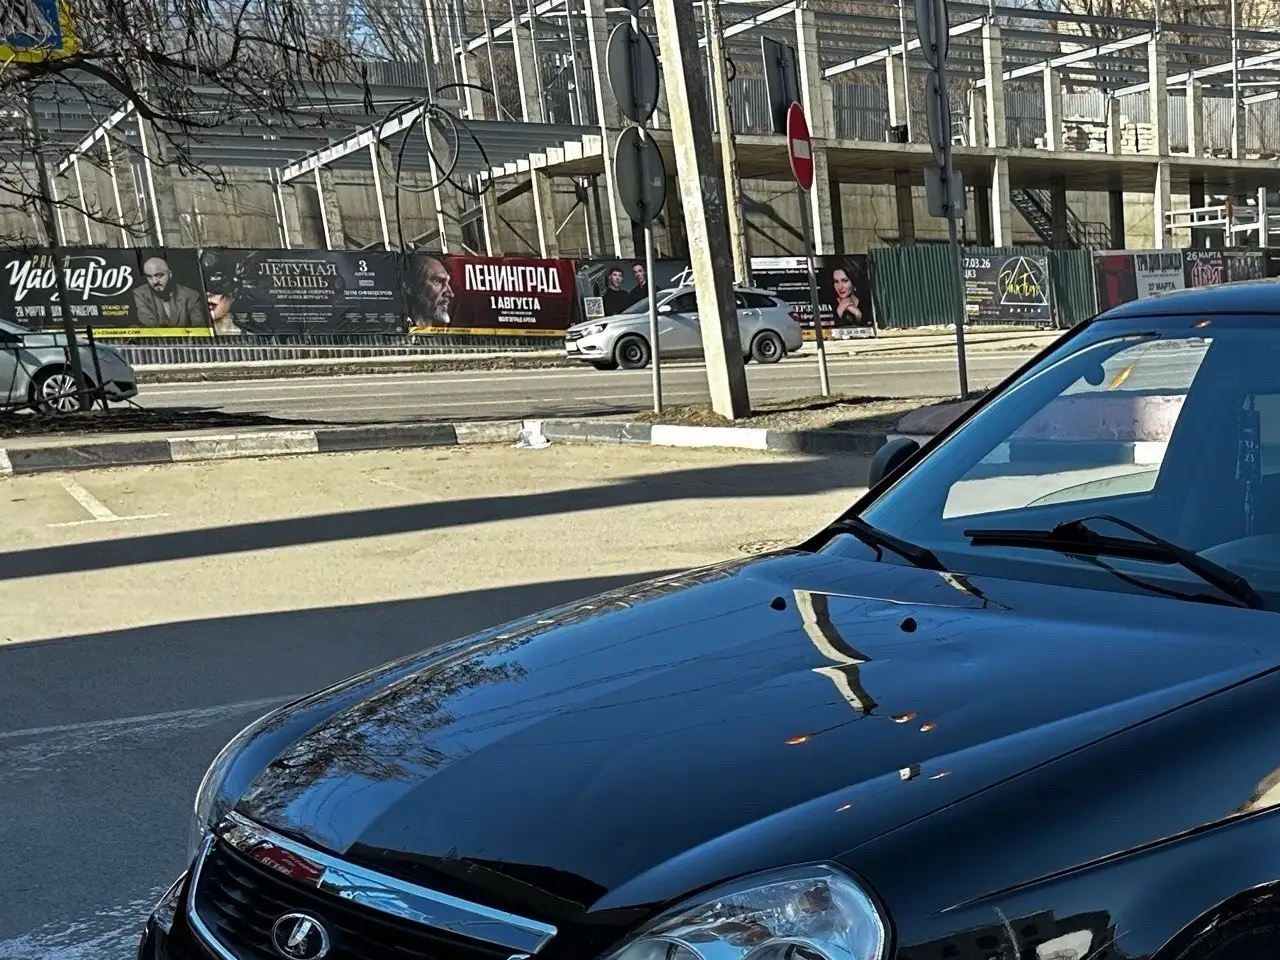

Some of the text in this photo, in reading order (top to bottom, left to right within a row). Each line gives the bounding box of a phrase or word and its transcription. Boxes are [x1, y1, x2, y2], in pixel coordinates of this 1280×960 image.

[1186, 251, 1198, 261] 26
[1198, 251, 1222, 260] МАРТА
[258, 262, 338, 276] ЛЕТУЧАЯ
[358, 260, 368, 272] 3
[273, 276, 329, 288] МЫШЬ
[464, 263, 562, 294] ЛЕНИНГРАД
[490, 295, 541, 311] 1 АВГУСТА
[24, 305, 46, 317] МАРТА
